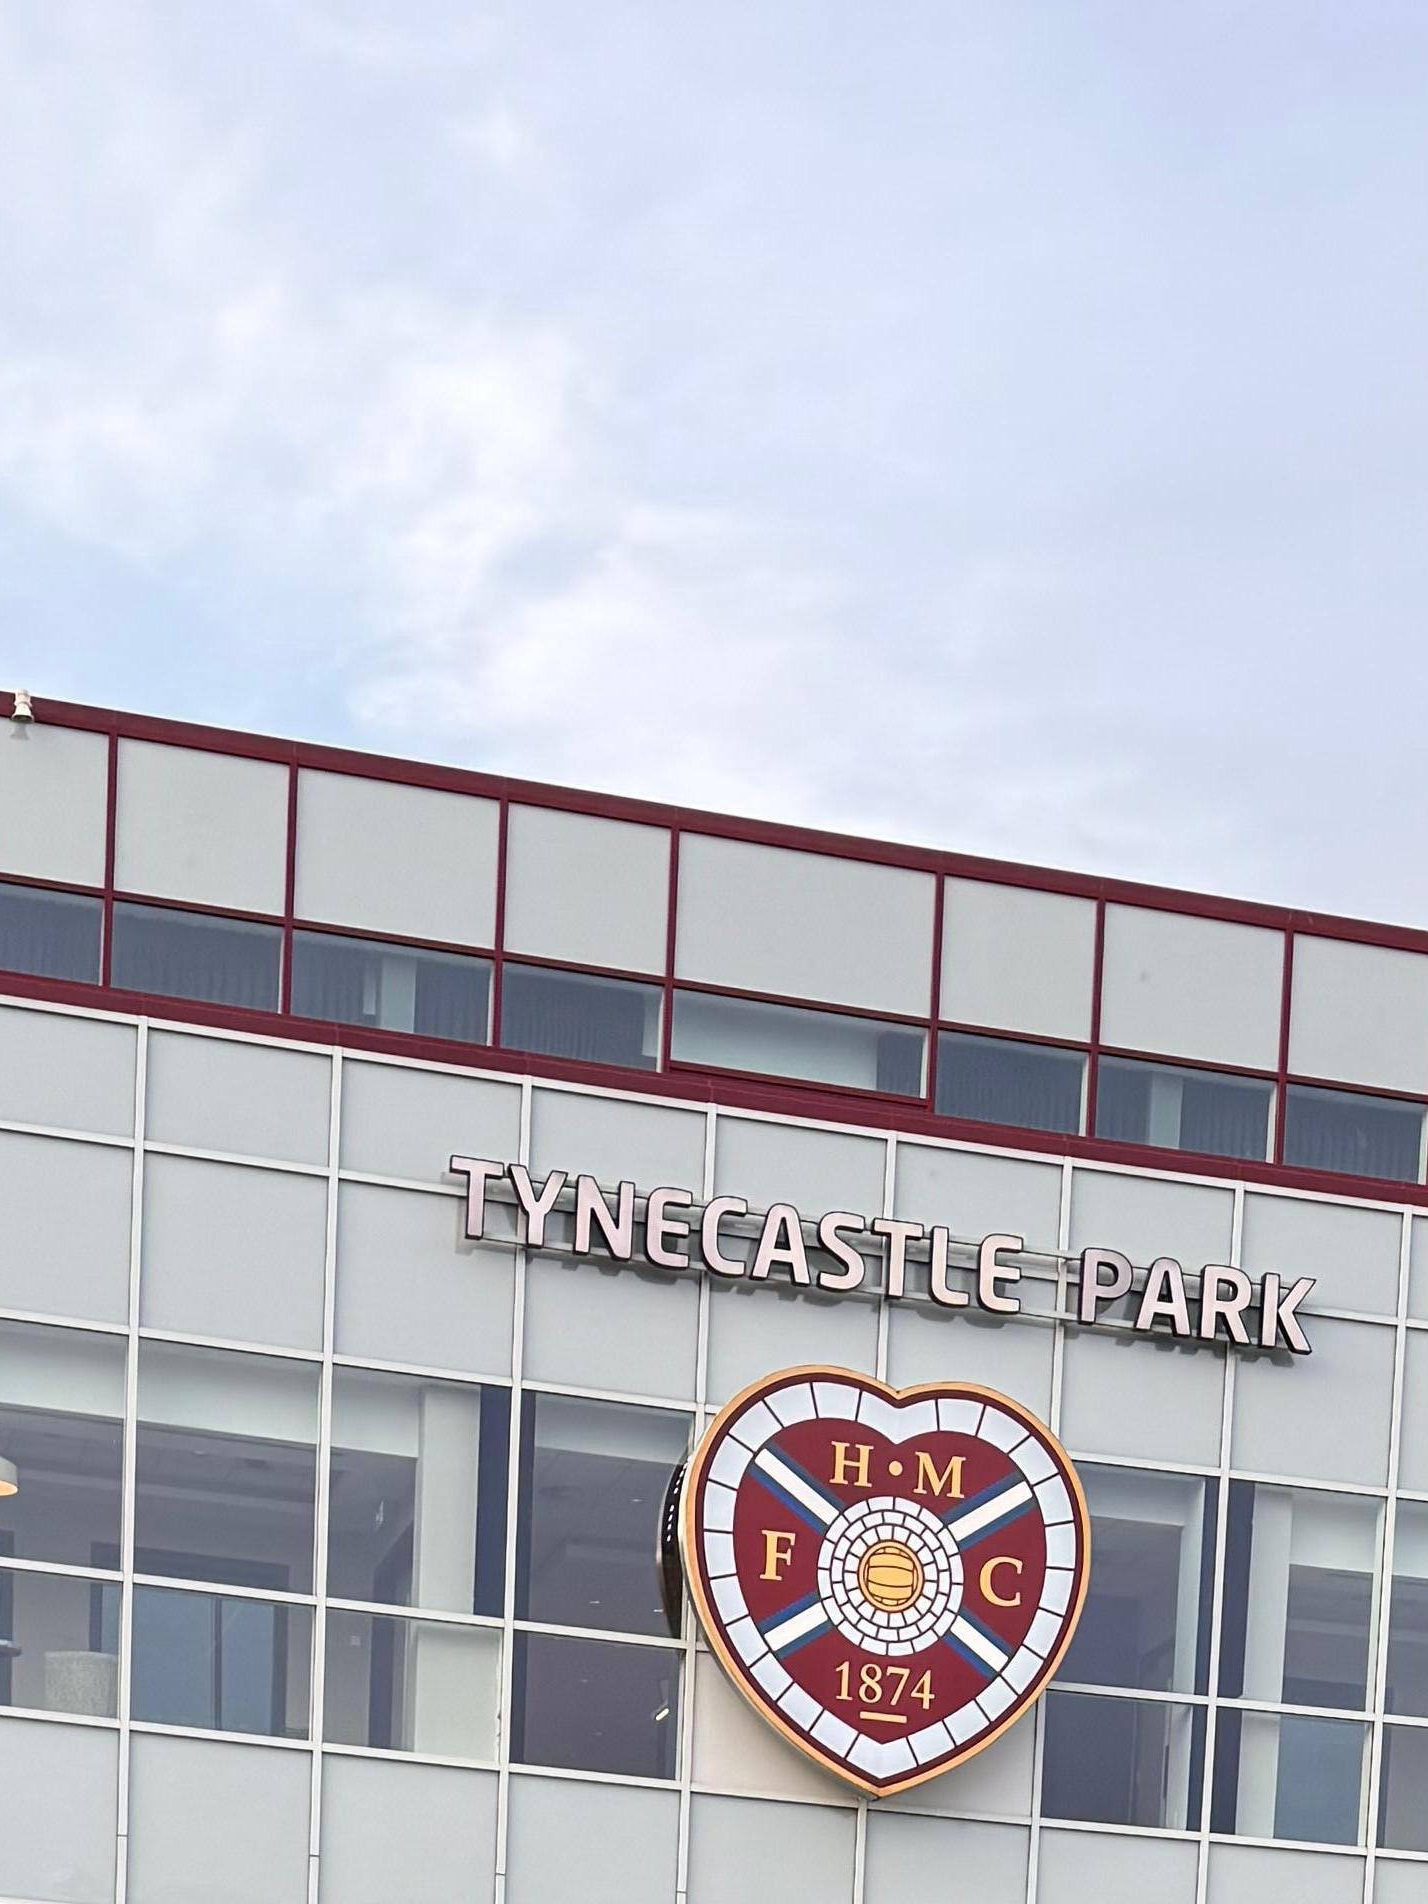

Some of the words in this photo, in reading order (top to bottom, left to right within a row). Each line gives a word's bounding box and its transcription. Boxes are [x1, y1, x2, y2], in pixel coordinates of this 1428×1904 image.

[450, 1154, 1024, 1313] TYNECASTLE
[1078, 1247, 1316, 1354] PARK
[829, 1440, 874, 1487] H
[914, 1451, 967, 1499] M
[759, 1529, 796, 1581] F
[979, 1556, 1023, 1606] C
[834, 1660, 935, 1710] 1874
